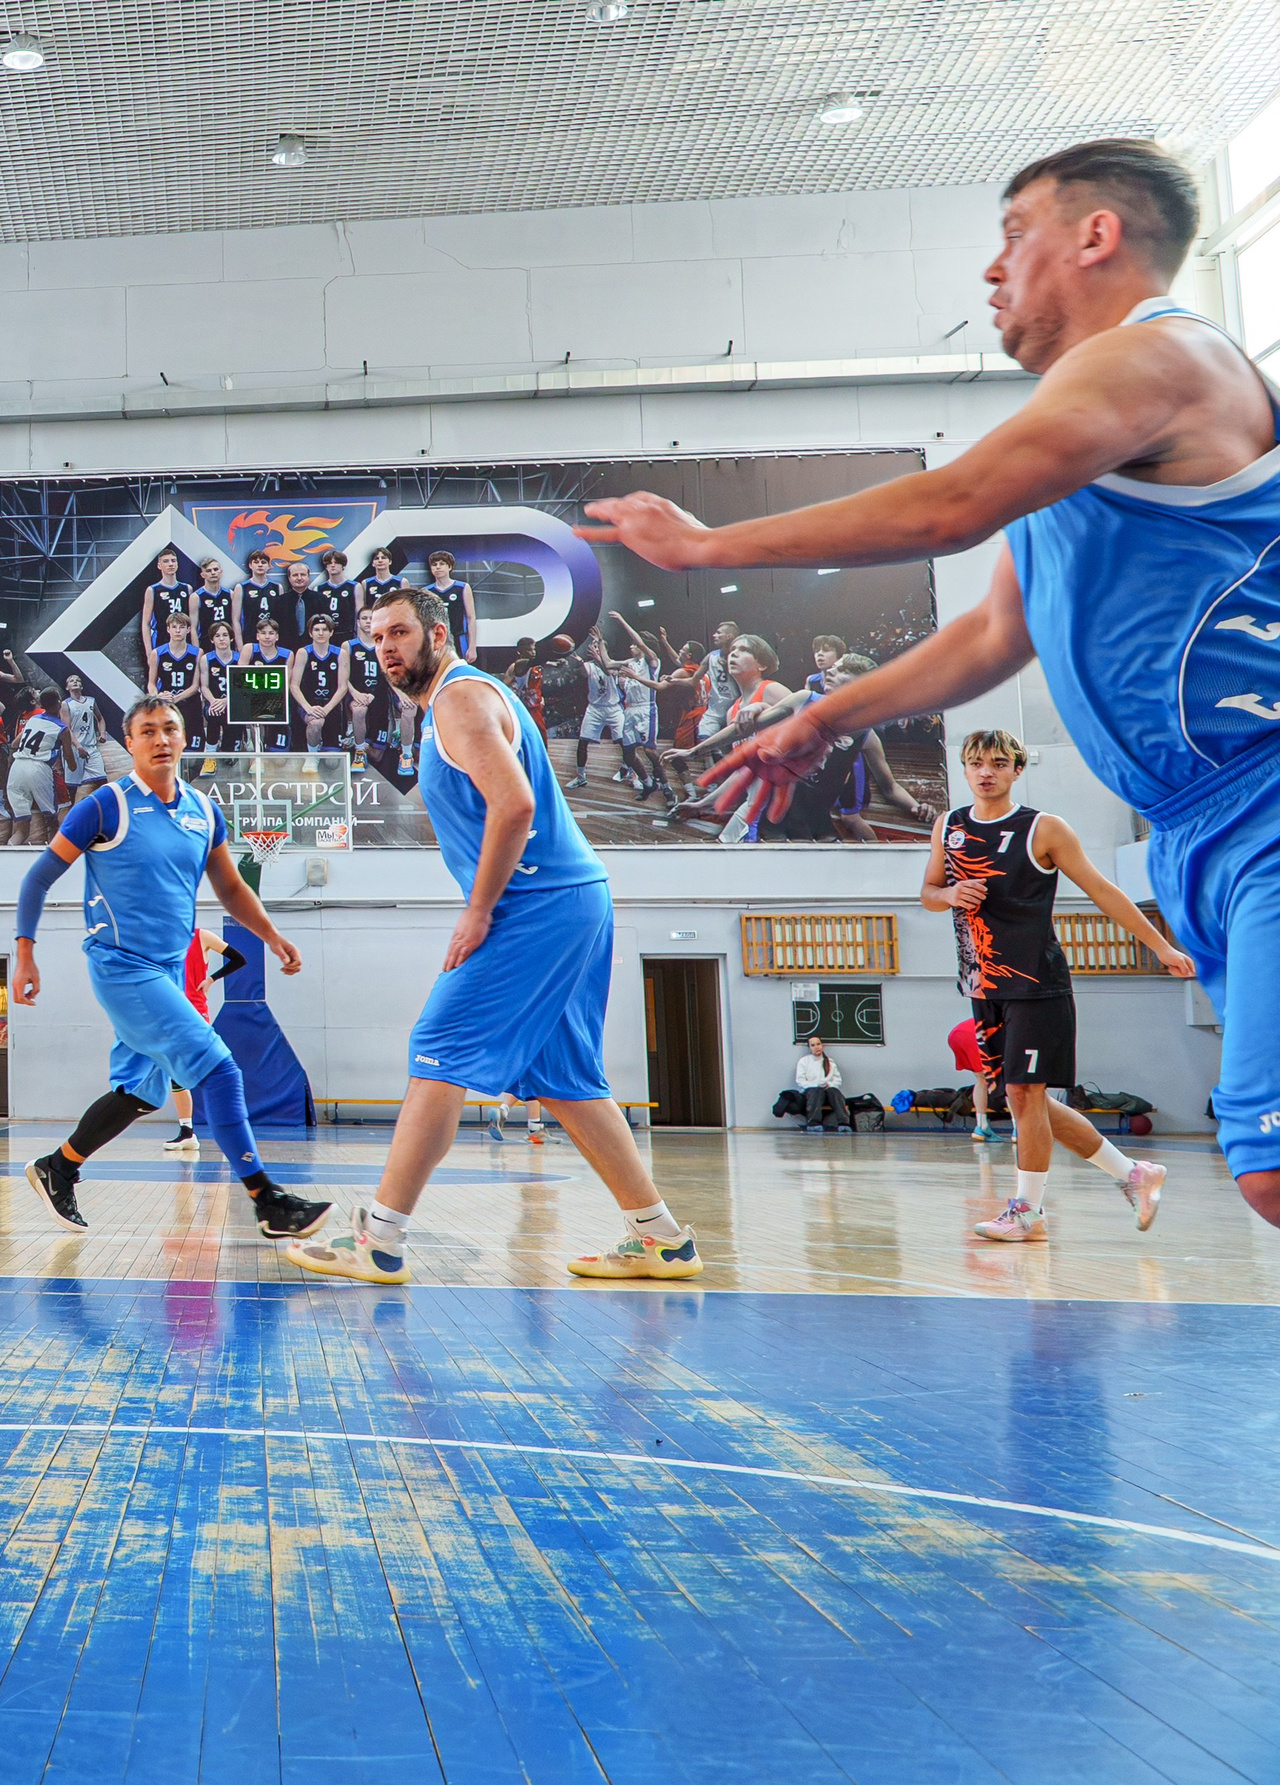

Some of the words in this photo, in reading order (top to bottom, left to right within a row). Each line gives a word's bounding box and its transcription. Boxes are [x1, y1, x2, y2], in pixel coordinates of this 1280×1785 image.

[169, 598, 182, 613] 34
[260, 597, 269, 610] 4
[213, 606, 225, 621] 23
[364, 661, 377, 677] 19
[171, 671, 184, 687] 13
[245, 672, 280, 689] 4.13
[318, 671, 326, 687] 5
[207, 777, 381, 806] АРХСТРОЙ
[997, 831, 1015, 853] 7
[1025, 1049, 1038, 1073] 7
